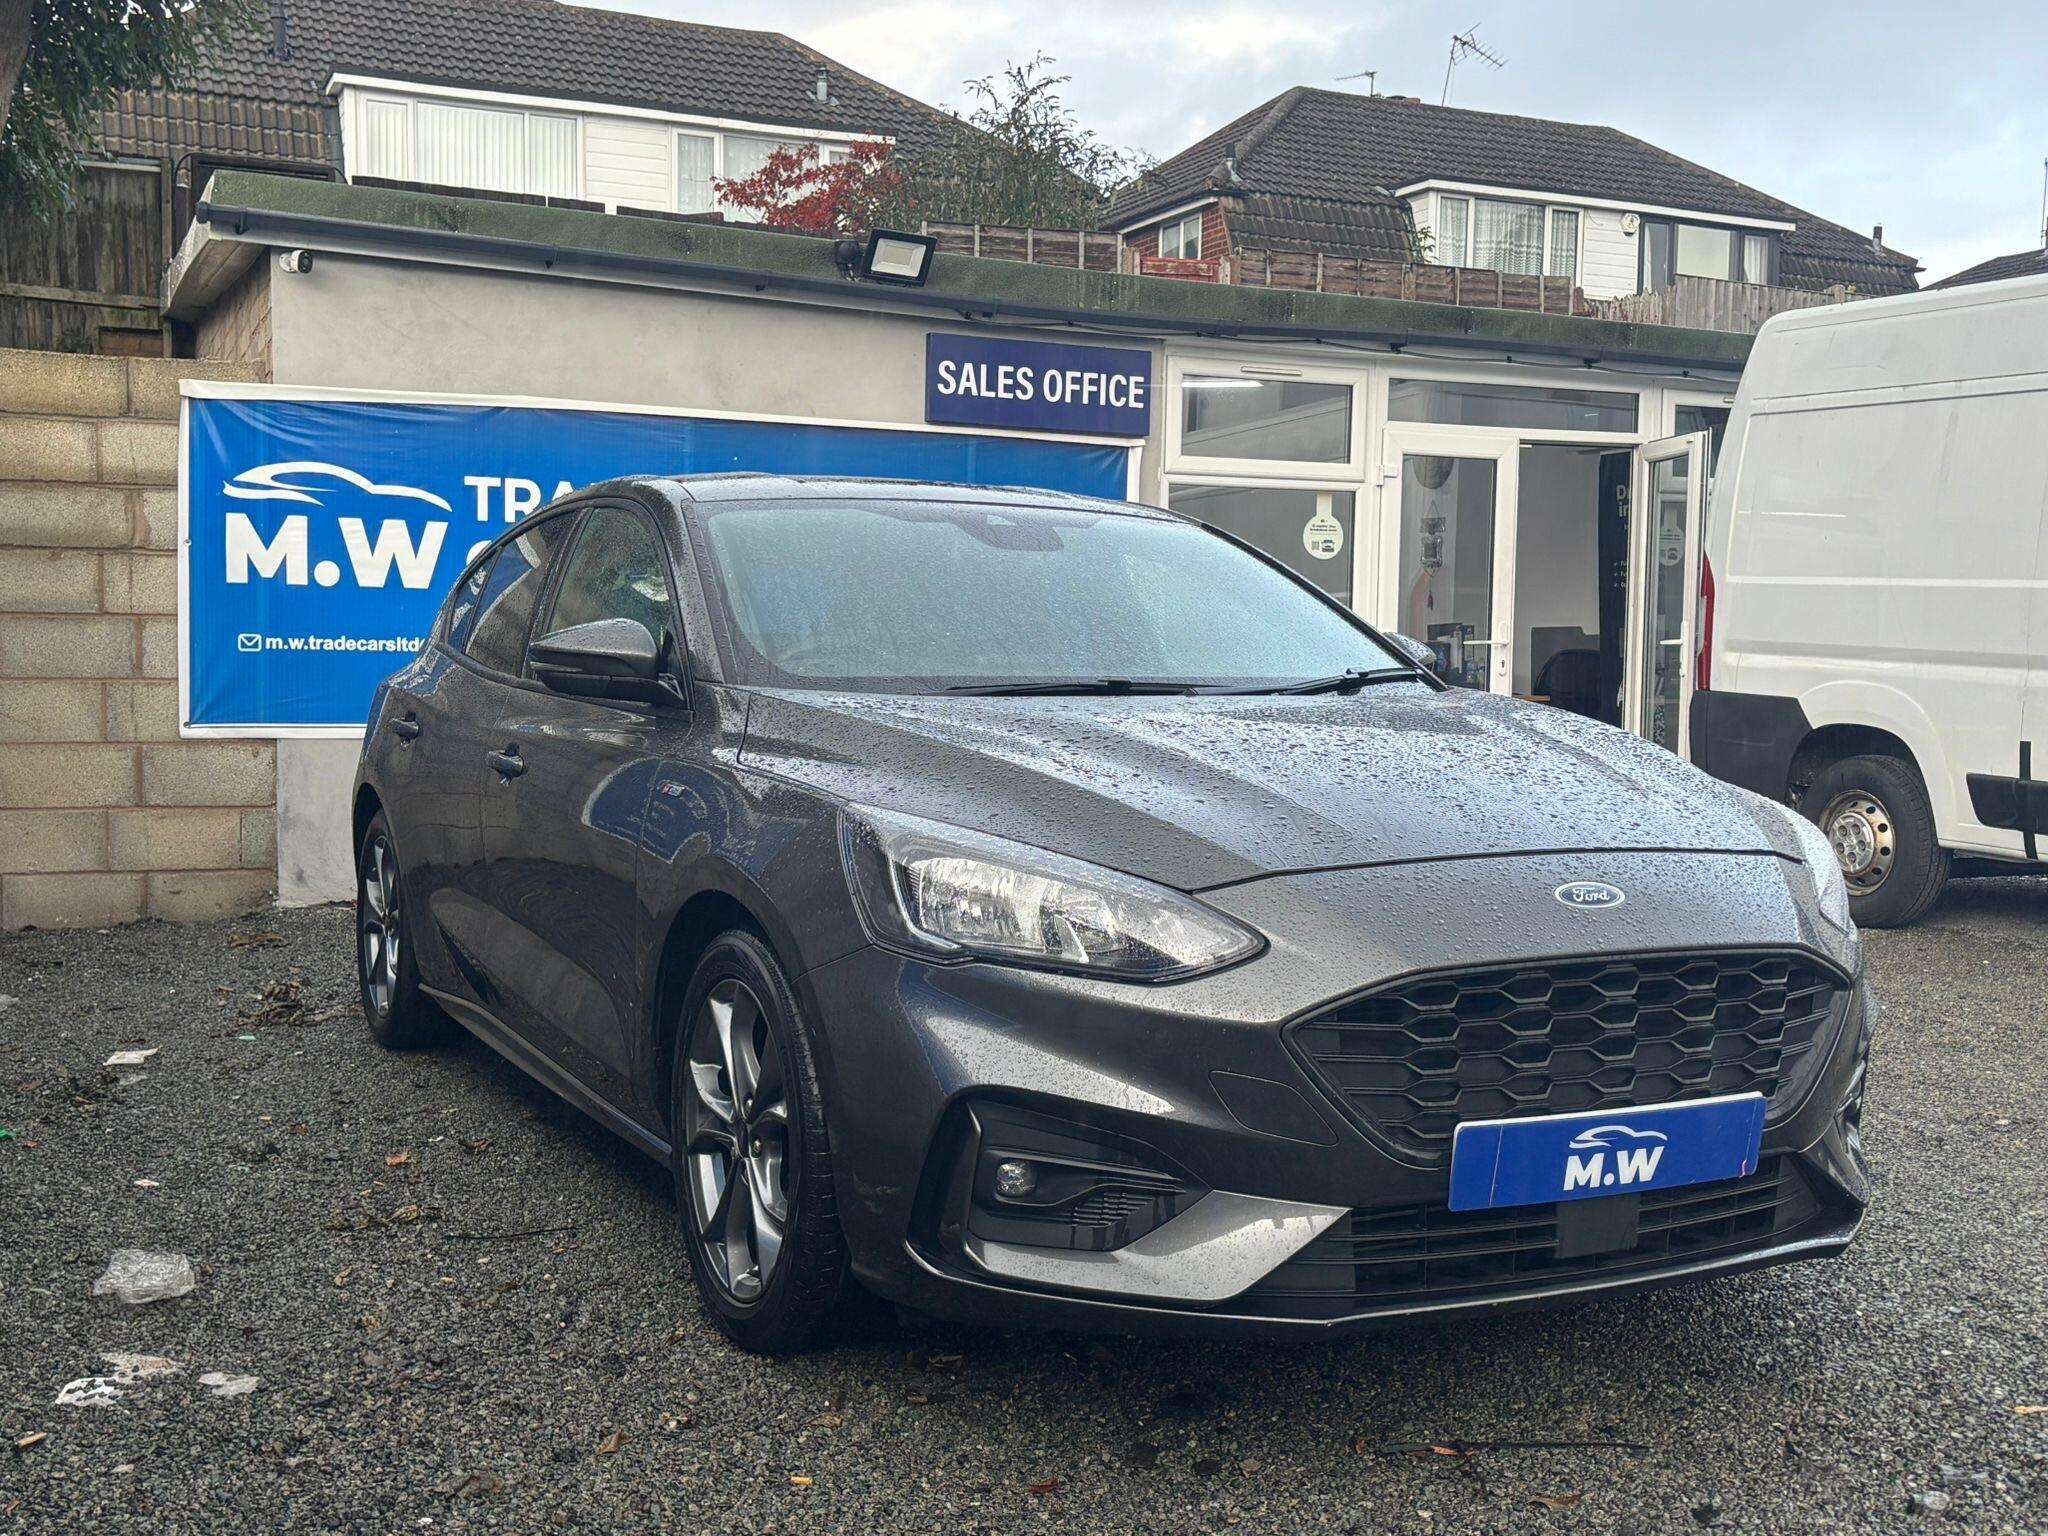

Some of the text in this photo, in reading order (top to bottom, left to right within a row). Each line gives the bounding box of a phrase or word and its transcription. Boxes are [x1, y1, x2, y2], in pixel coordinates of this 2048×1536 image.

[937, 360, 1145, 409] SALES OFFICE
[225, 512, 449, 590] M.W
[265, 635, 425, 653] m.w.tradecarsltd
[1572, 886, 1611, 902] Ford
[1563, 1145, 1665, 1191] M.W
